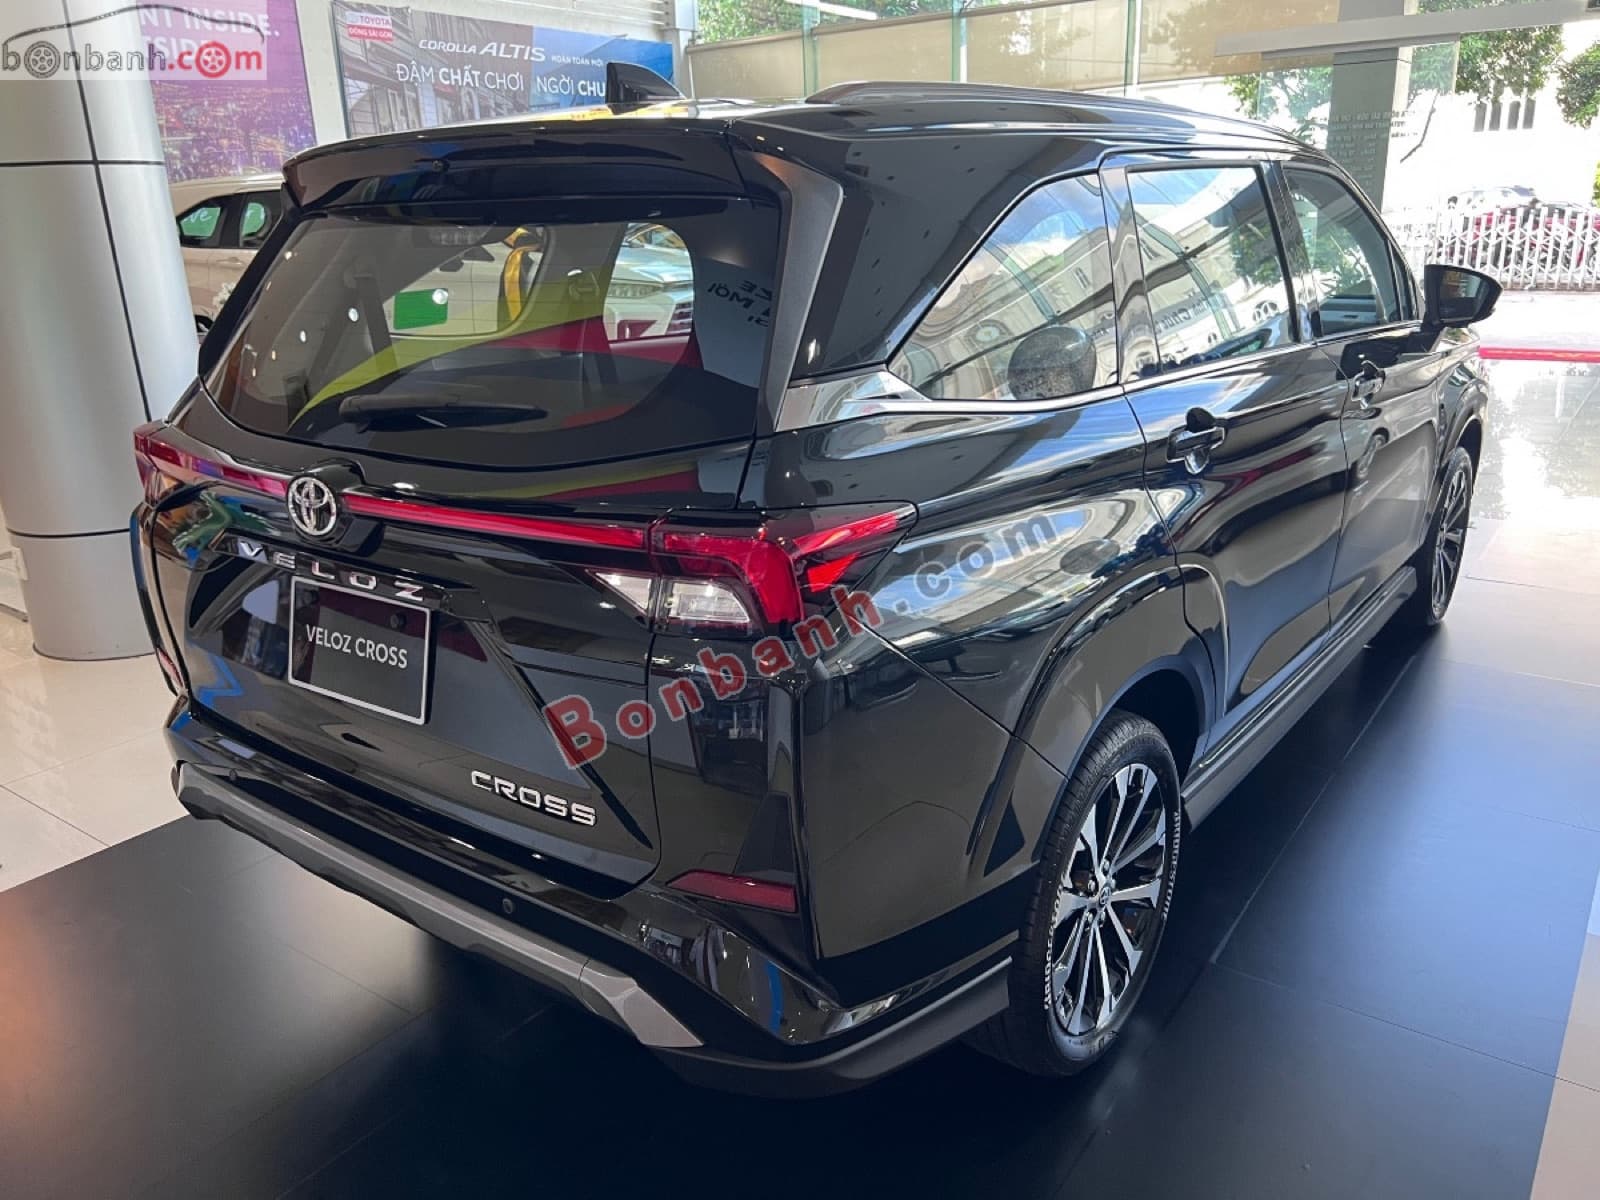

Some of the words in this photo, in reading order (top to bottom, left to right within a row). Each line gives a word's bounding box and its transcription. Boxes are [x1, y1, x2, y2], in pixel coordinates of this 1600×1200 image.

[184, 8, 280, 37] INSIDE.
[360, 15, 391, 25] TOYOTA
[418, 39, 477, 54] COROLLA
[480, 42, 546, 62] ALTIS
[396, 60, 435, 86] ĐẬM
[439, 64, 481, 88] CHẤT
[484, 71, 524, 91] CHƠI
[536, 75, 575, 94] NGỜI
[240, 541, 423, 602] VELOZ
[306, 623, 352, 654] VELOZ
[355, 636, 408, 669] CROSS
[471, 770, 596, 826] CROSS
